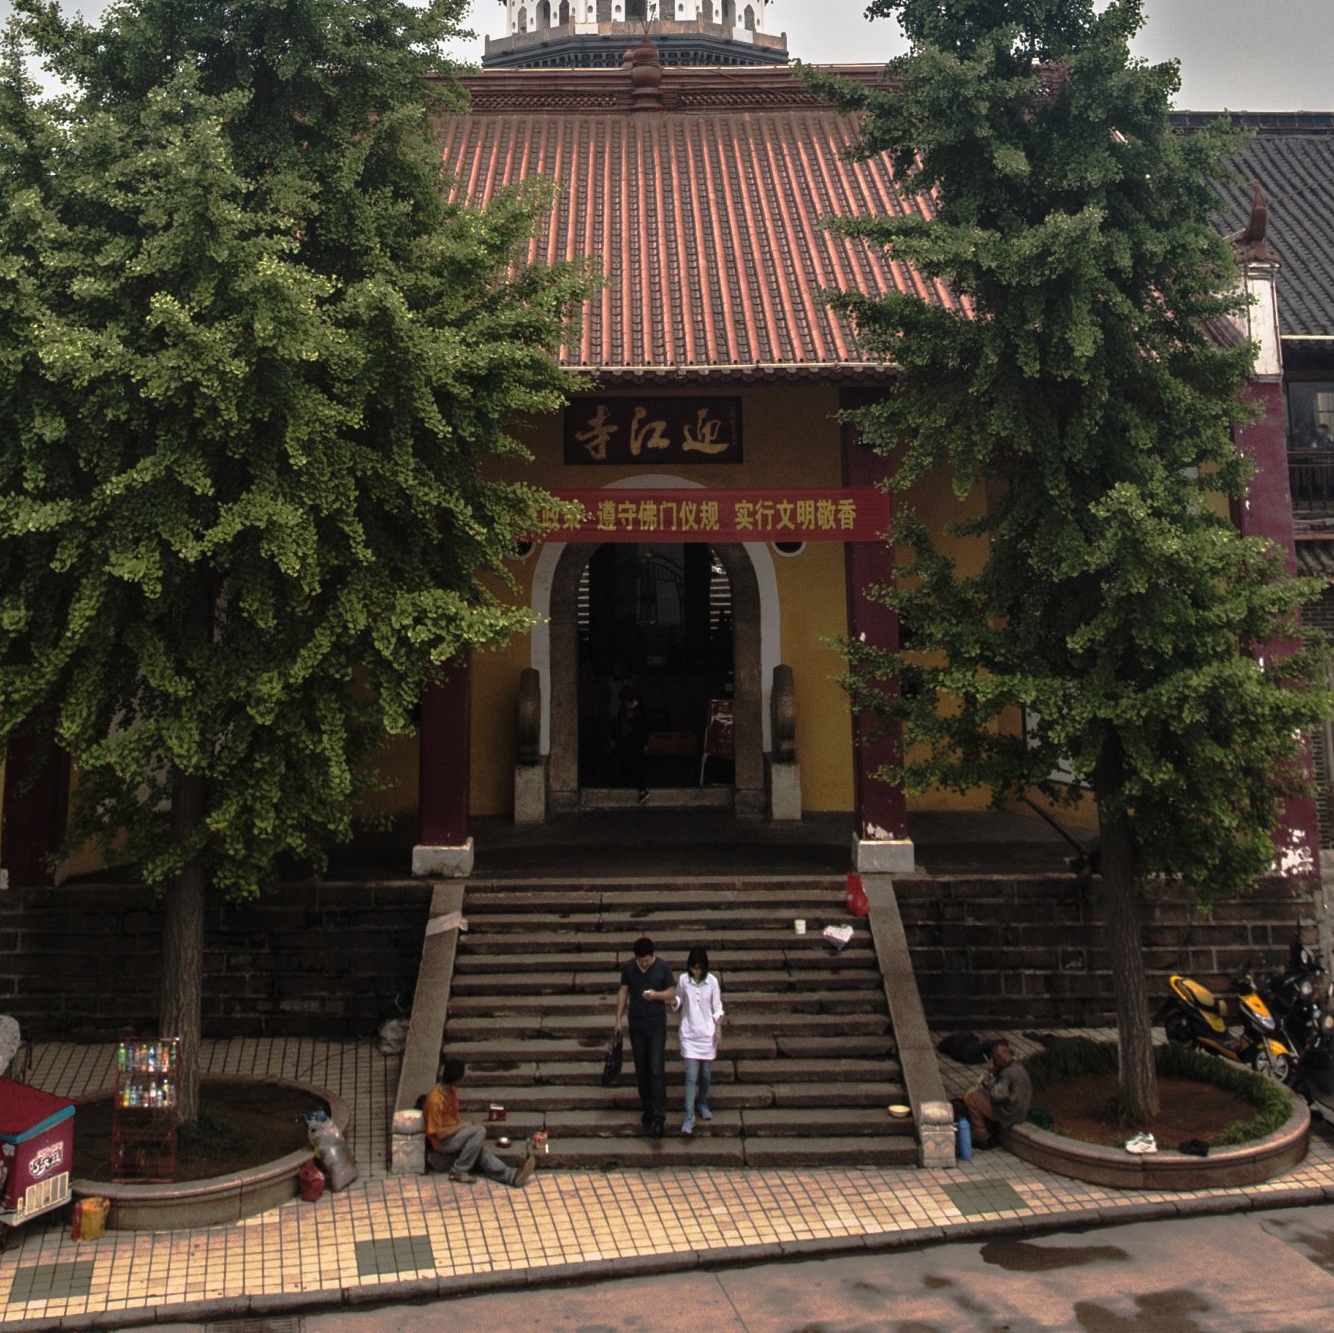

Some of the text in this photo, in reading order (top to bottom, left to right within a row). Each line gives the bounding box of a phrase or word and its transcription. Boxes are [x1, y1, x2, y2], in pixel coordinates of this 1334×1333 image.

[575, 404, 731, 460] 迎江寺
[596, 500, 720, 531] 遵守佛门仪规
[735, 499, 857, 531] 实行文明敬香
